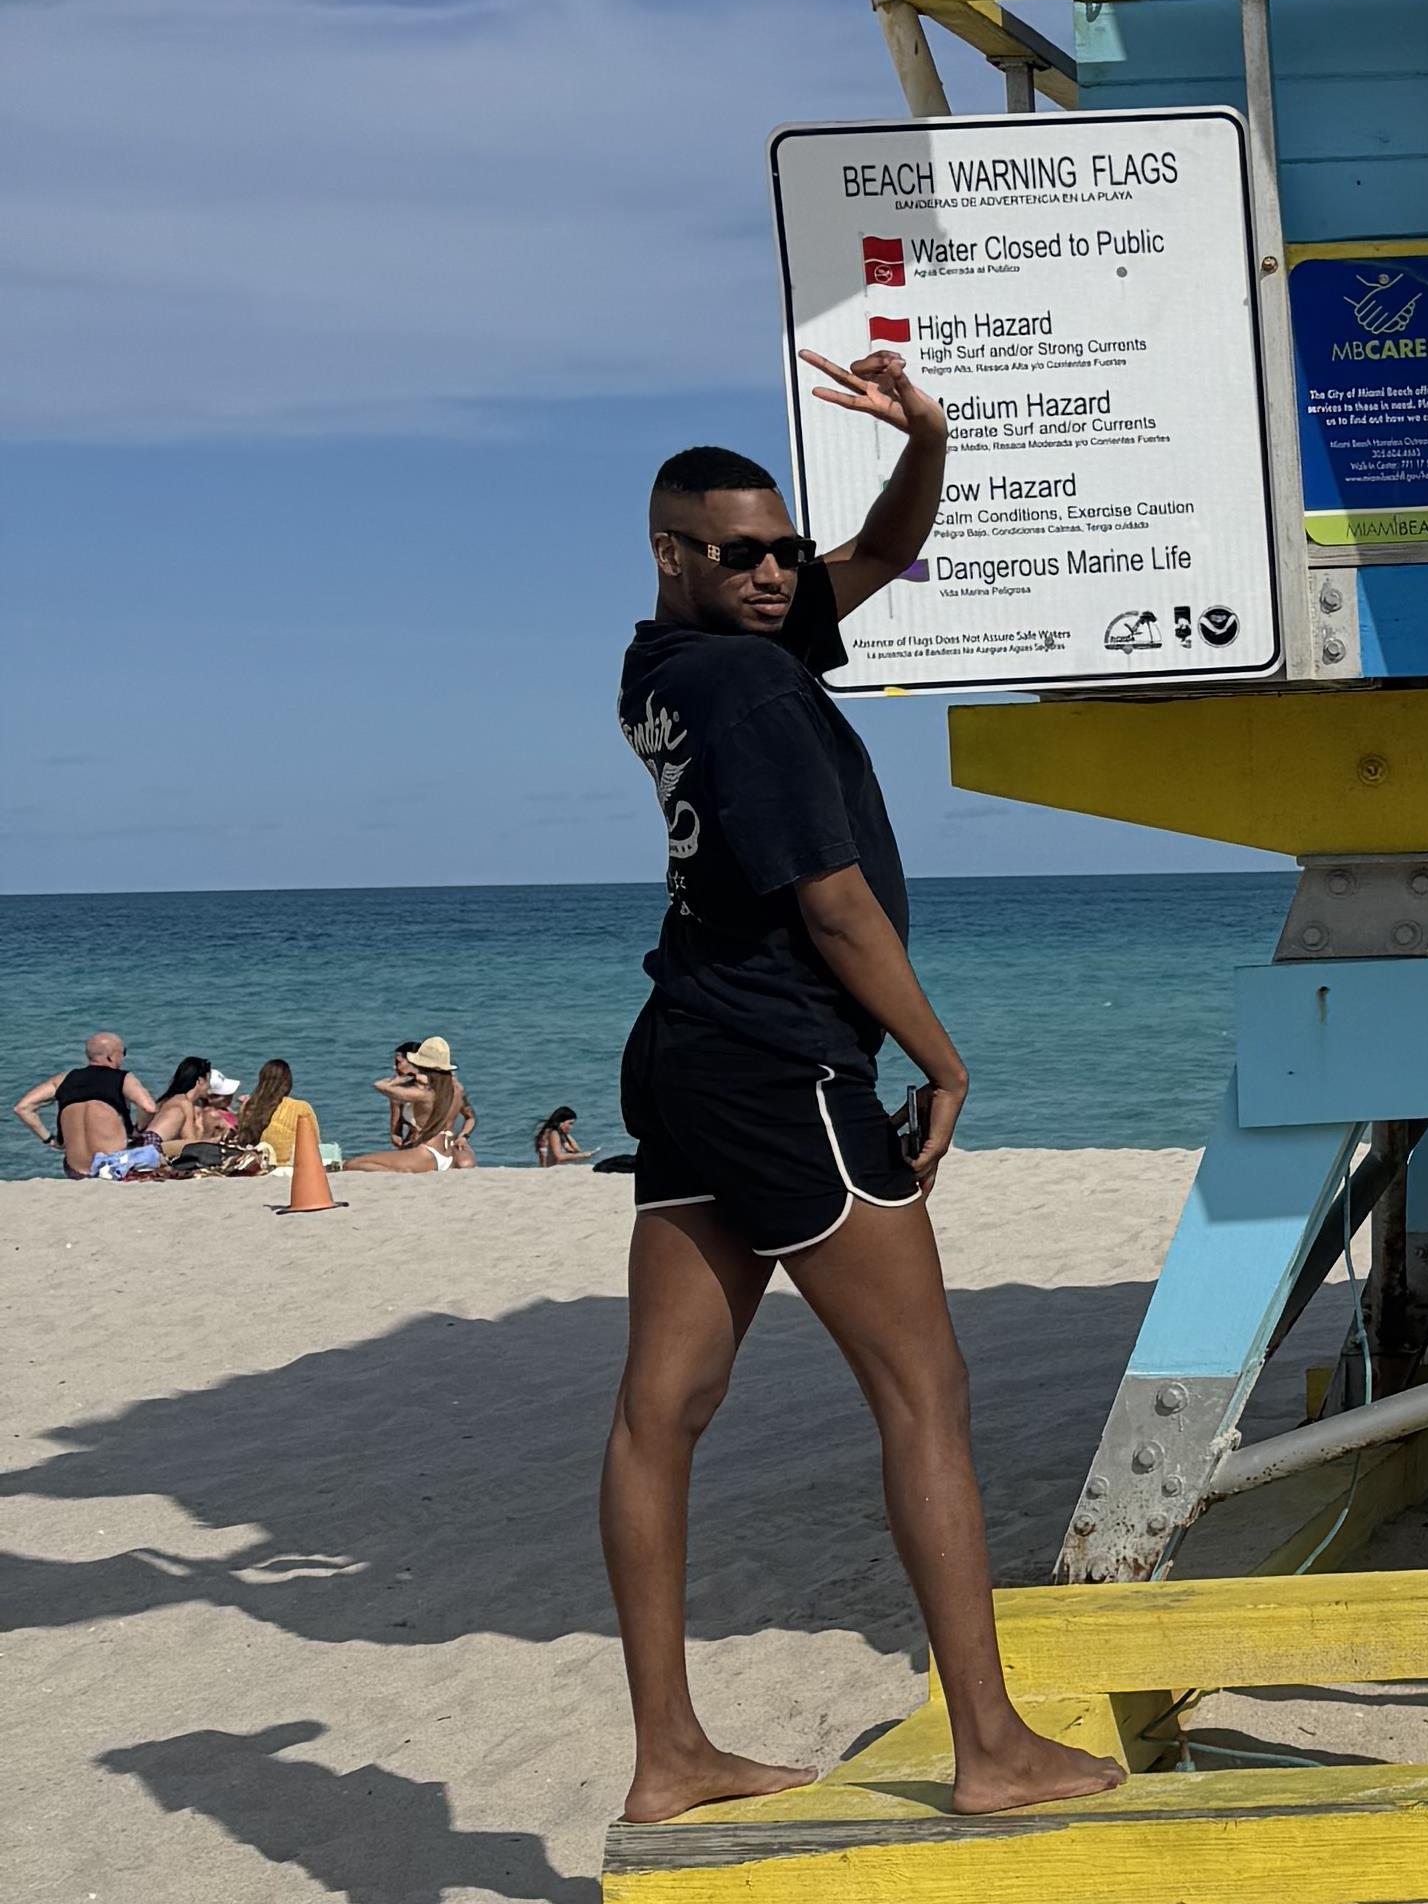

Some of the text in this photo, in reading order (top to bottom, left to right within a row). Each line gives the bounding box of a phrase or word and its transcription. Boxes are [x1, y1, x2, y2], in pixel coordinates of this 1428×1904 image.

[843, 152, 1178, 196] BEACH WARNING FLAGS
[962, 197, 977, 207] DE
[980, 193, 1061, 206] ADVERTENCIA
[1063, 193, 1078, 202] EN
[1081, 193, 1095, 201] LA
[1098, 191, 1133, 201] PLAYA
[911, 229, 1165, 264] Water Closed to Public
[918, 311, 1052, 345] High Hazard
[920, 338, 1147, 363] High Surf and/or Strong Currents
[1027, 390, 1110, 417] Hazard
[1310, 390, 1325, 400] The
[1328, 388, 1344, 401] City
[1346, 388, 1355, 399] of
[1387, 385, 1413, 397] Beach
[948, 417, 1156, 439] derate Surf and/or Currents
[1350, 414, 1366, 424] find
[990, 473, 1077, 500] Hazard
[935, 500, 1194, 526] Calm Conditions, Exercise Caution
[937, 545, 1191, 584] Dangerous Marine Life
[961, 587, 990, 596] Marina
[992, 585, 1031, 596] Peligrosa
[896, 637, 906, 646] of
[935, 634, 960, 644] Does
[962, 634, 981, 643] Not
[983, 632, 1014, 642] Assure
